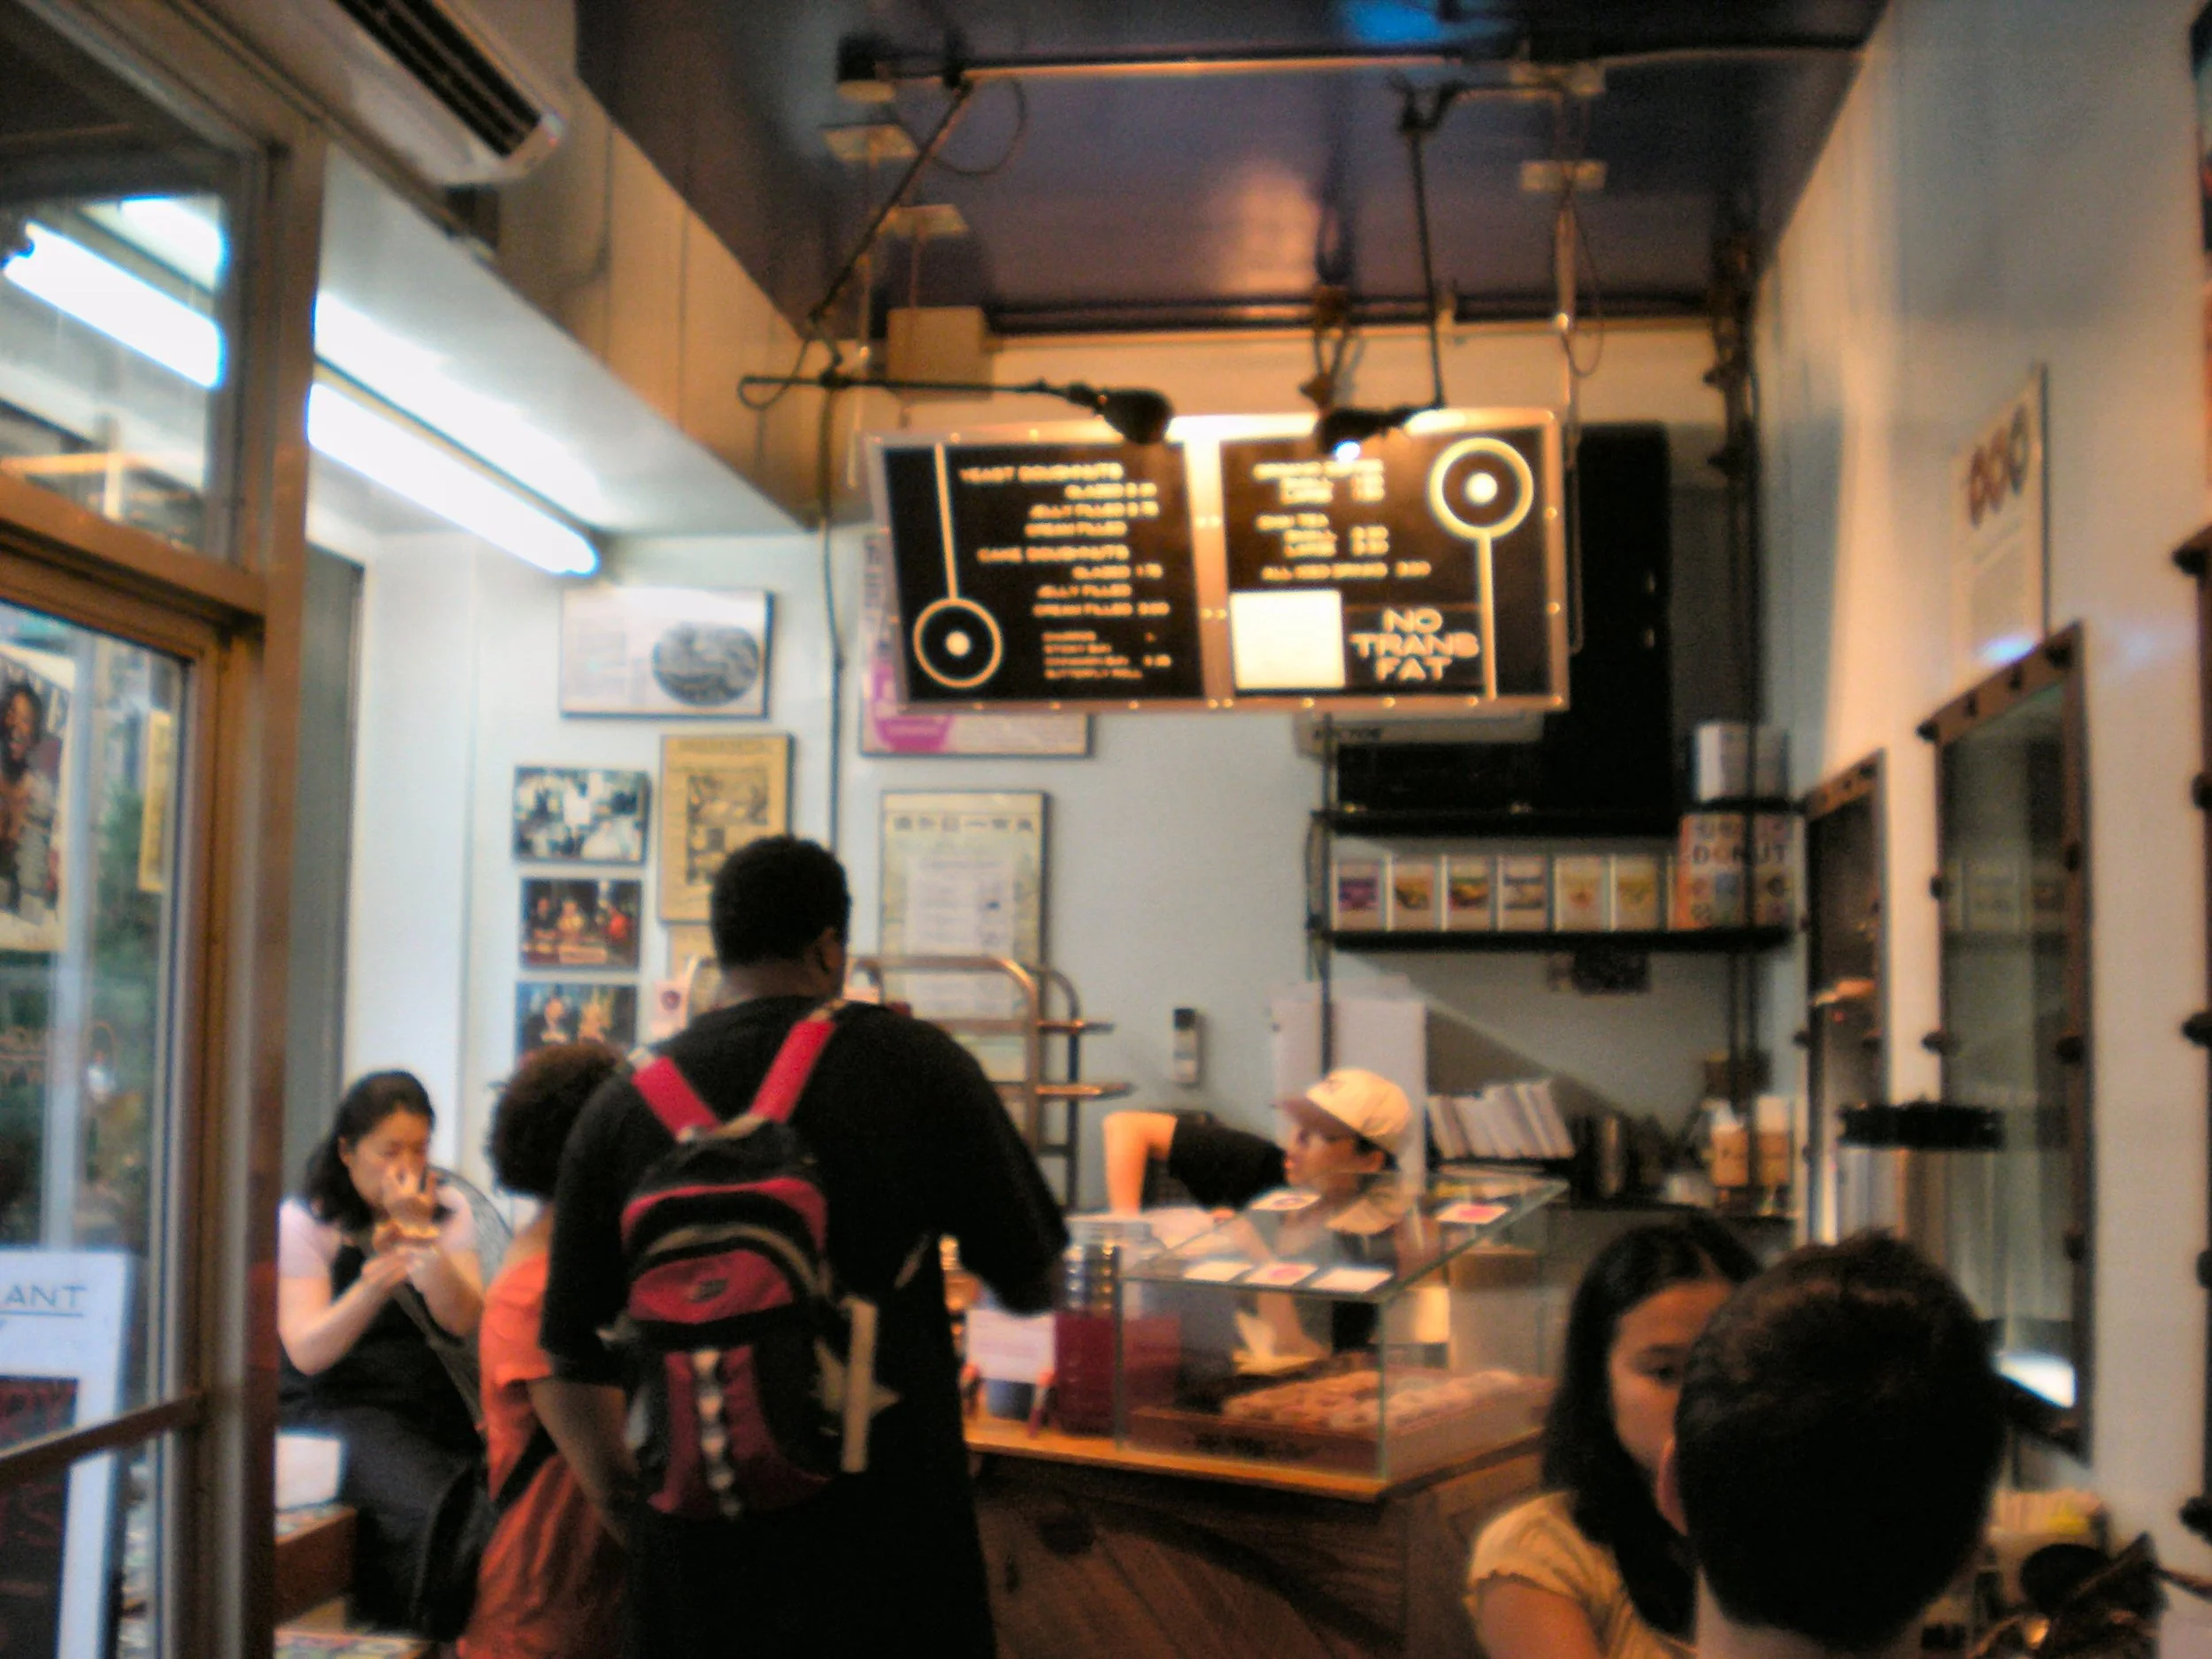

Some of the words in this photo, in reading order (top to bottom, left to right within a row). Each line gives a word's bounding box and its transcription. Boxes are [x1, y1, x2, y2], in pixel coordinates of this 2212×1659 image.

[1383, 607, 1444, 634] NO
[1348, 632, 1479, 658] TRANS
[1374, 657, 1453, 681] FAT
[4, 1284, 88, 1308] ANT
